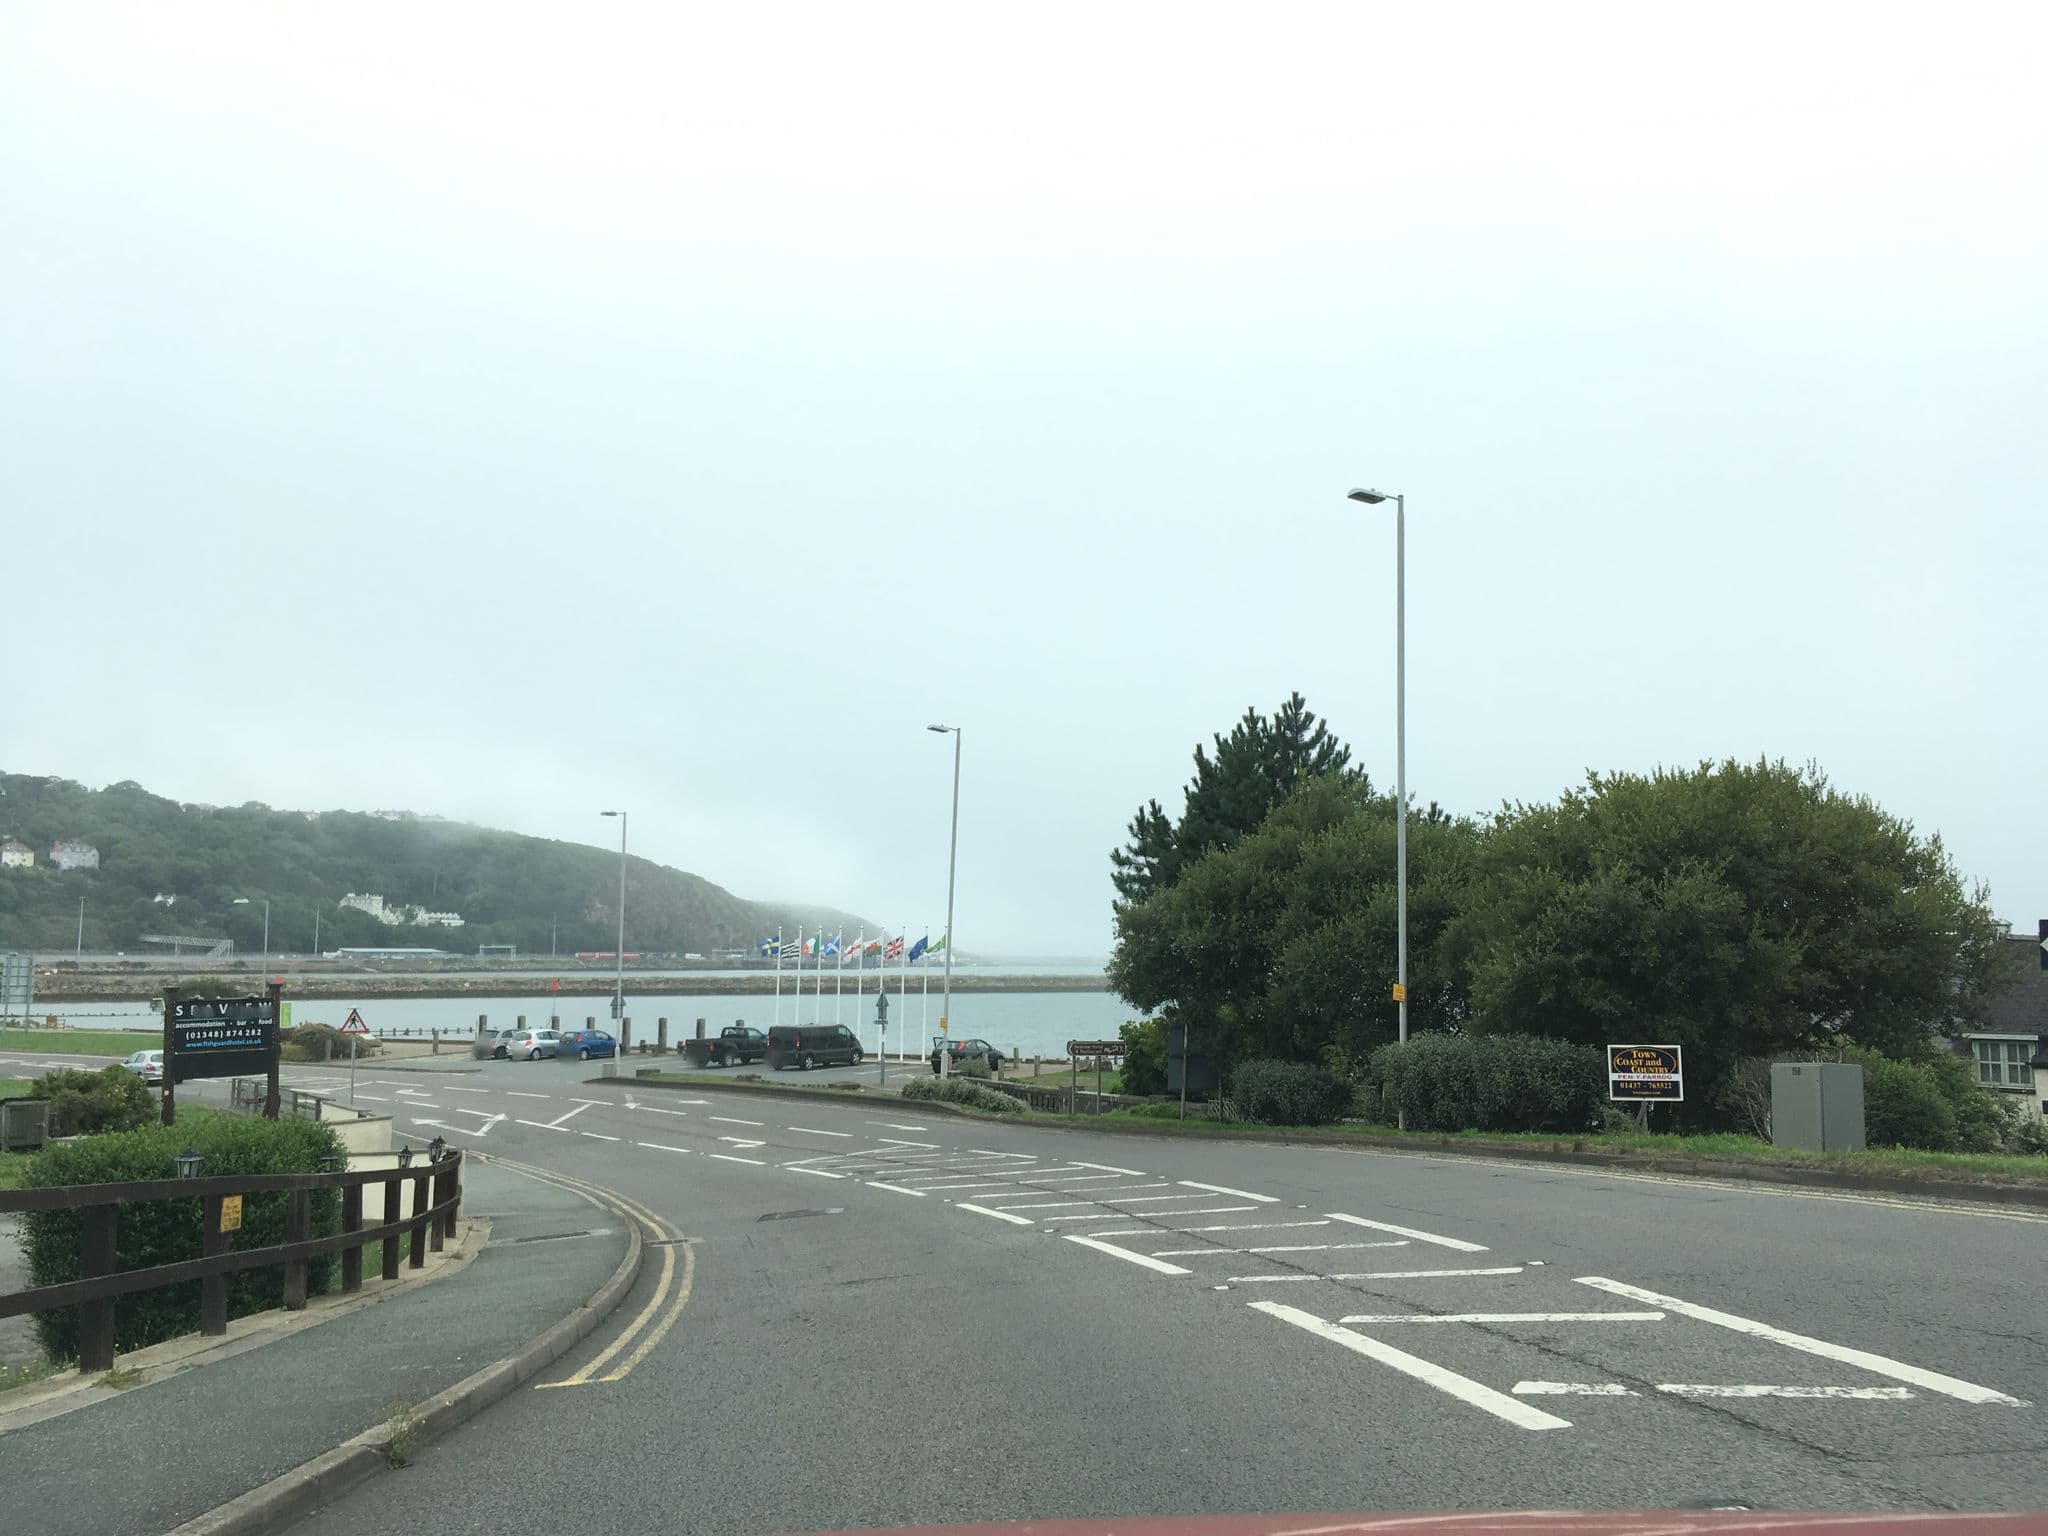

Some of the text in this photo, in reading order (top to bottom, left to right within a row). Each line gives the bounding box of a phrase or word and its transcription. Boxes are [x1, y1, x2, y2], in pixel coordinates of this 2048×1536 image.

[176, 1021, 225, 1029] accommodation
[186, 1031, 223, 1040] (01348)
[186, 1039, 261, 1048] www.fishguardhotel.co.uk
[1646, 1058, 1662, 1066] and
